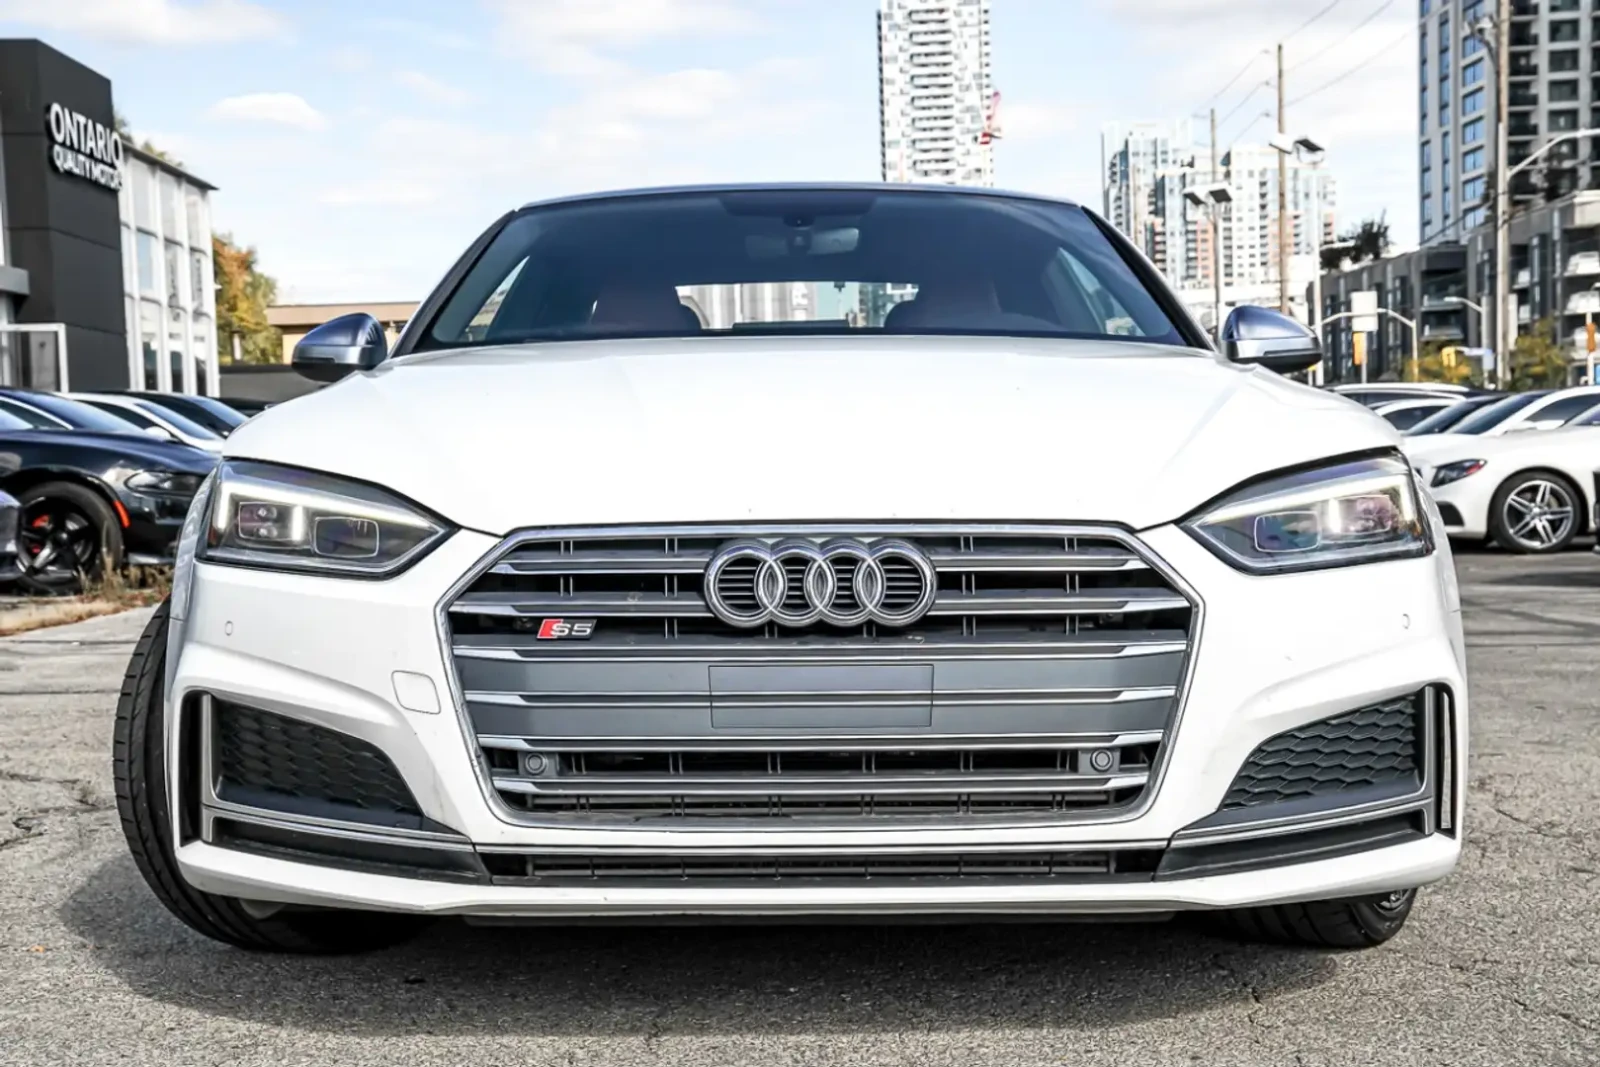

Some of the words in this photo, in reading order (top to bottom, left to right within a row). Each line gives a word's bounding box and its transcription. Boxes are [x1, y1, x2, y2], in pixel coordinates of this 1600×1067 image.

[49, 102, 123, 166] ONTARIO
[53, 144, 91, 179] QUALITY
[549, 621, 593, 637] S5
